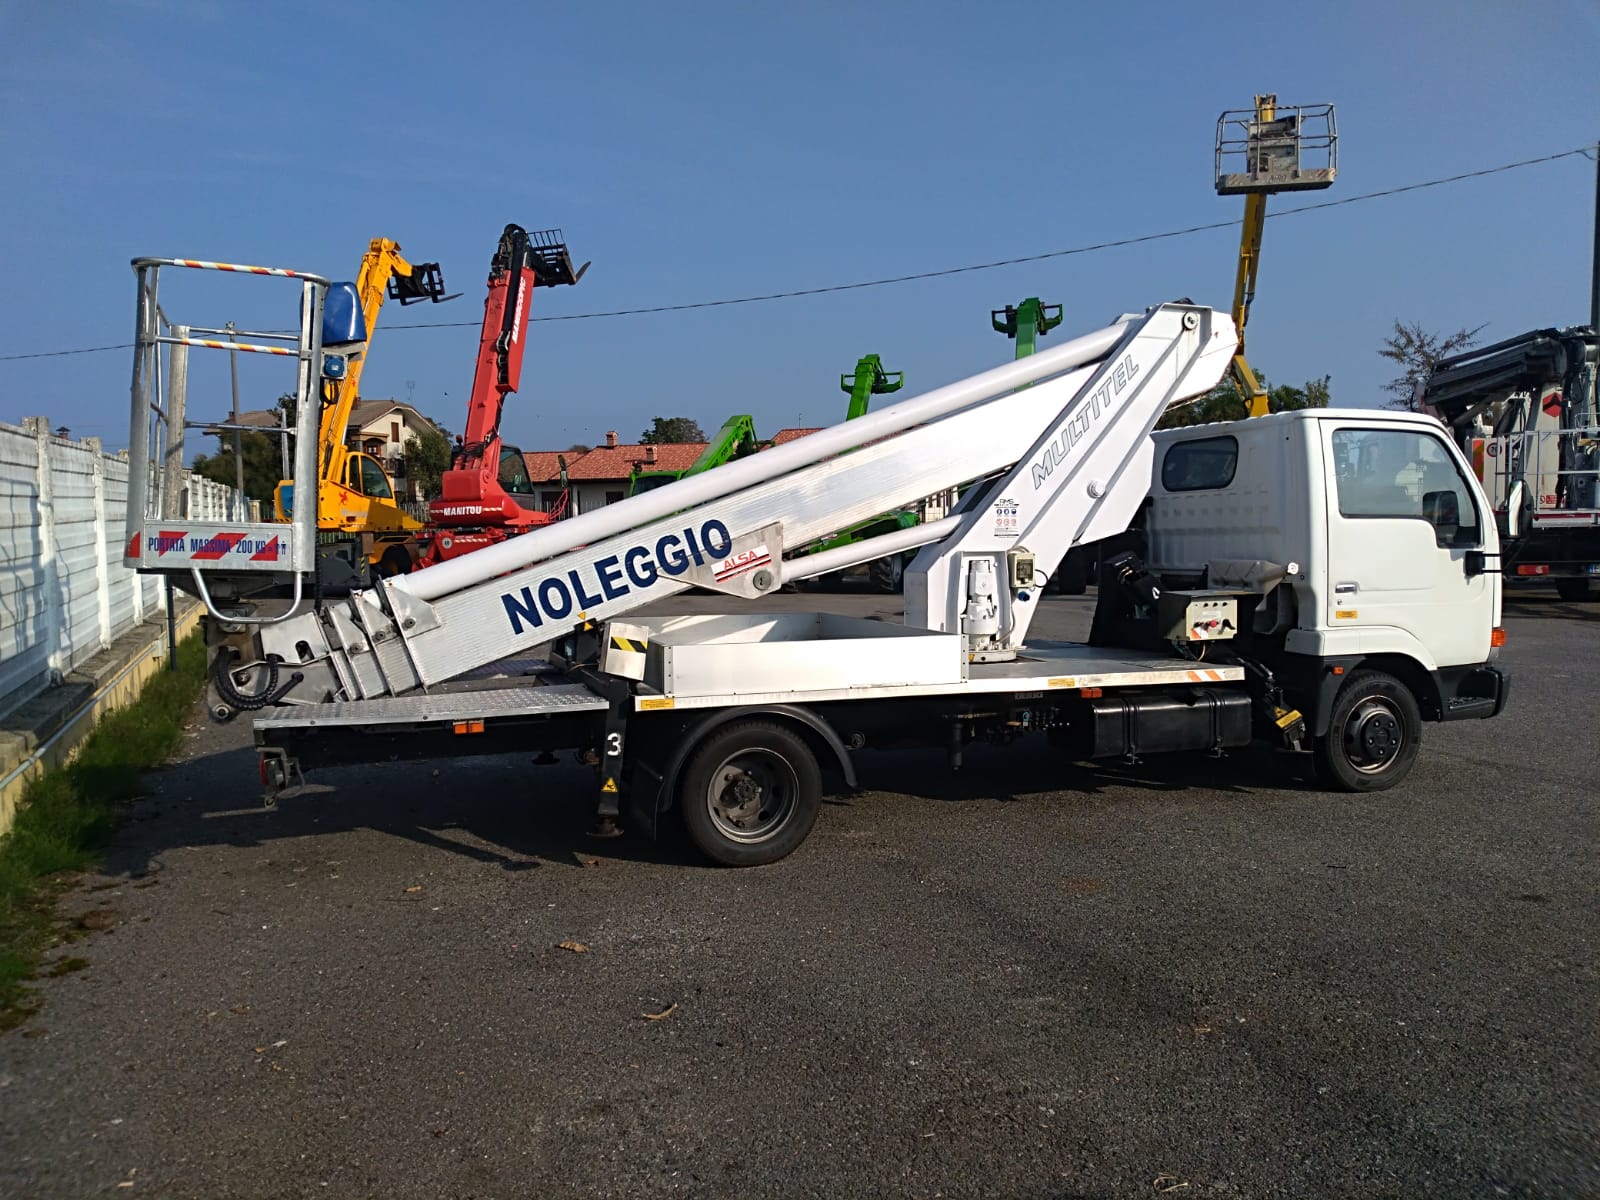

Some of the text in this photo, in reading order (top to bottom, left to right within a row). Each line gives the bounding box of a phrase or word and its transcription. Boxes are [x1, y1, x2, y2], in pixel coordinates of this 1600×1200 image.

[1031, 353, 1139, 490] MULTITEL
[443, 506, 482, 516] MANITOU
[148, 537, 185, 552] PORTATA
[190, 538, 231, 553] MASSIMA
[236, 539, 253, 554] 200
[255, 540, 266, 554] KG
[723, 550, 758, 570] ALSA
[500, 519, 733, 635] NOLEGGIO
[607, 732, 622, 756] 3
